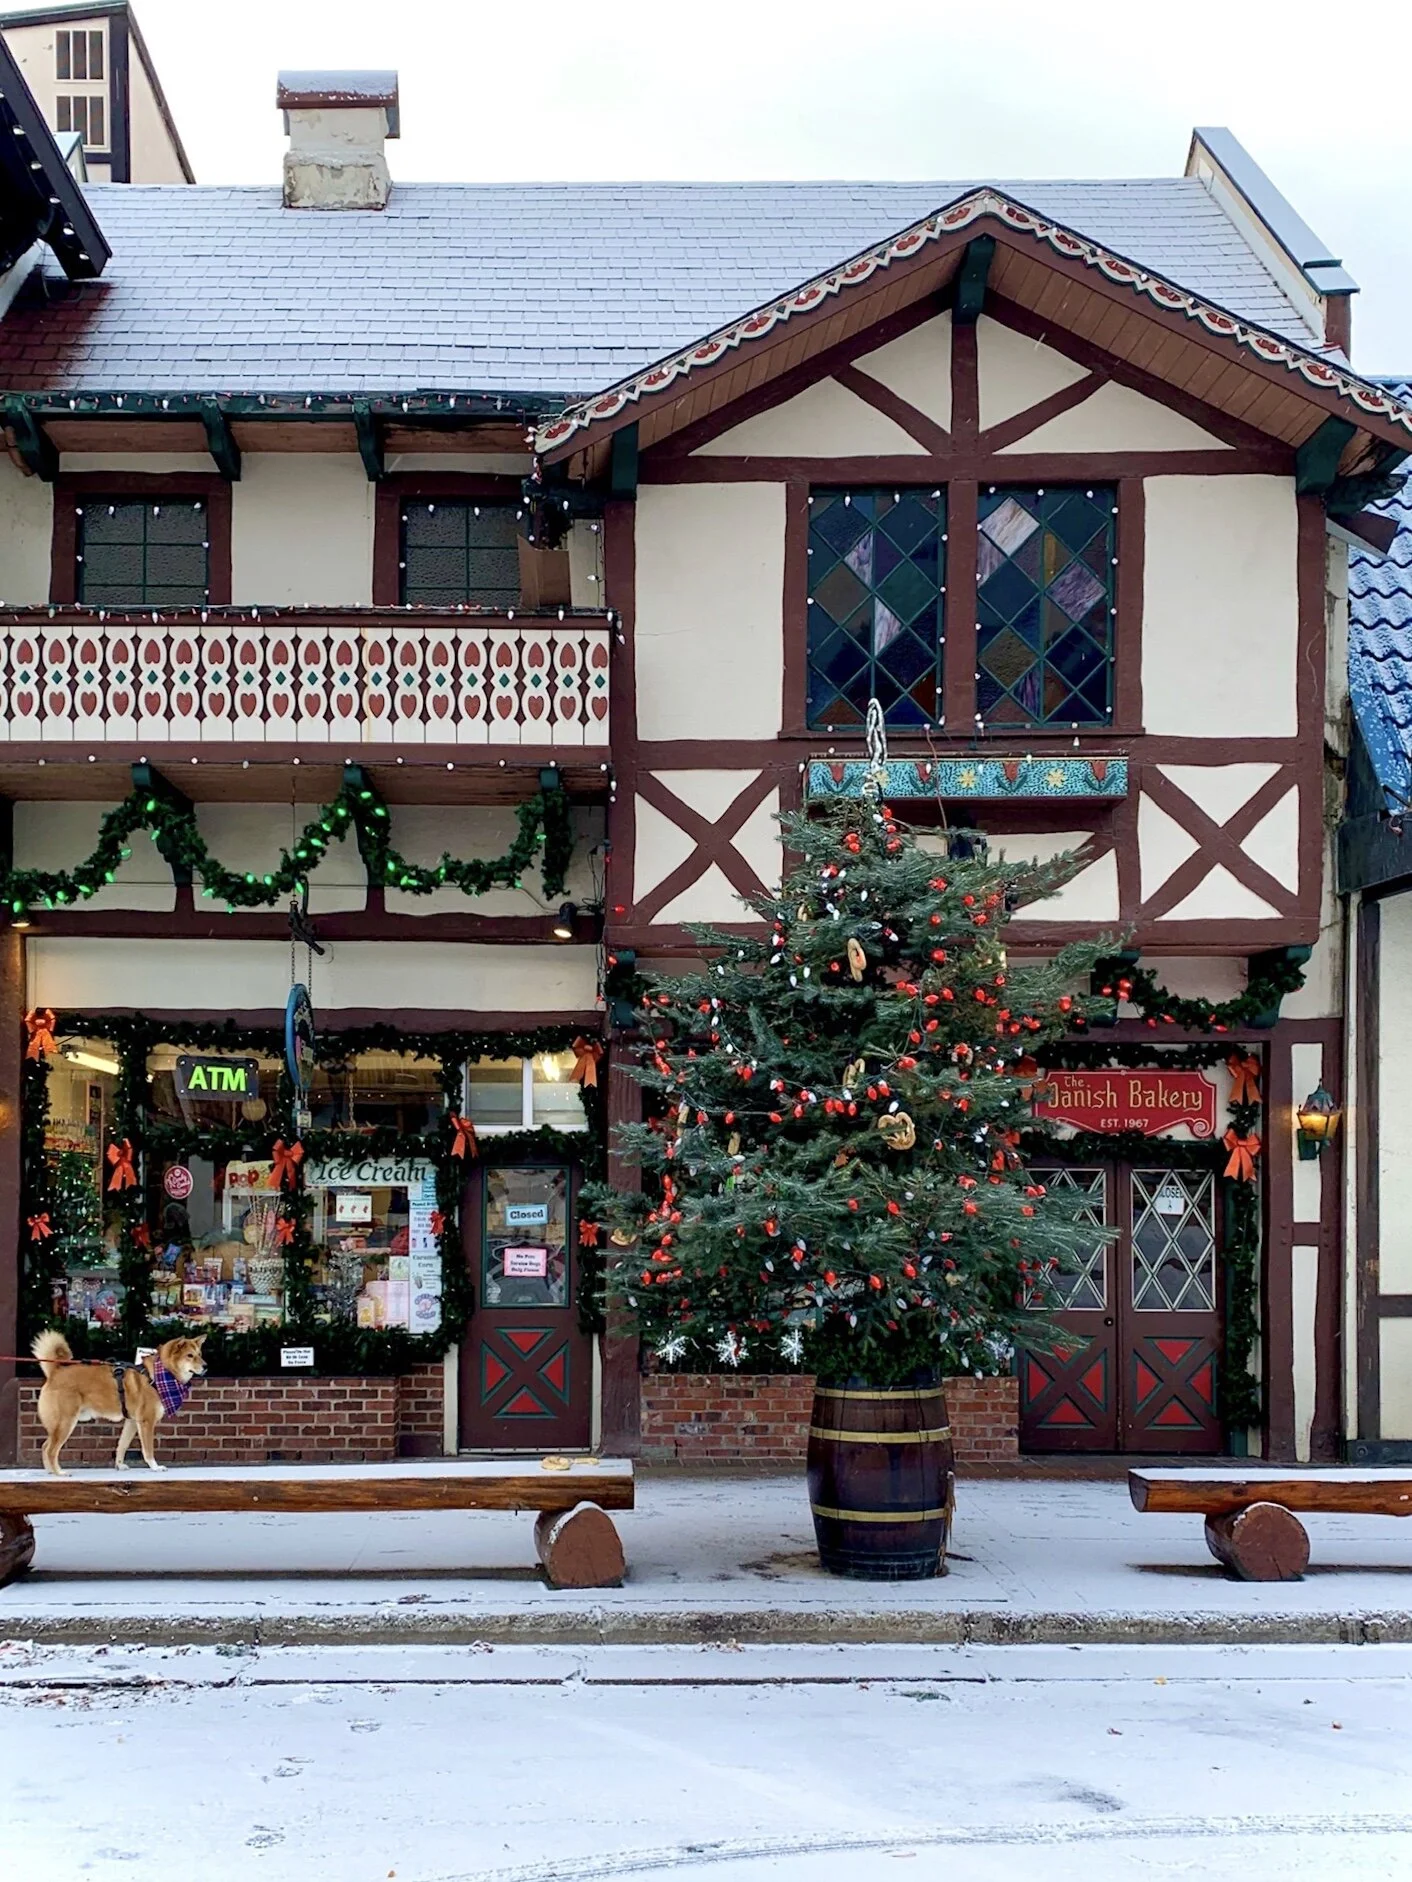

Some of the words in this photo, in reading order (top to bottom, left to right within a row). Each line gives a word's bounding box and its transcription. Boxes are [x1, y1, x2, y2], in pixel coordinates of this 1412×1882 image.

[188, 1065, 247, 1091] ATM
[1064, 1075, 1085, 1088] The
[1129, 1079, 1203, 1112] Bakery
[1101, 1118, 1121, 1128] EST.
[1124, 1118, 1149, 1128] 1967
[317, 1162, 352, 1181] Ice
[356, 1162, 427, 1182] Cream
[1158, 1187, 1185, 1199] LOSE
[510, 1209, 544, 1220] Closed
